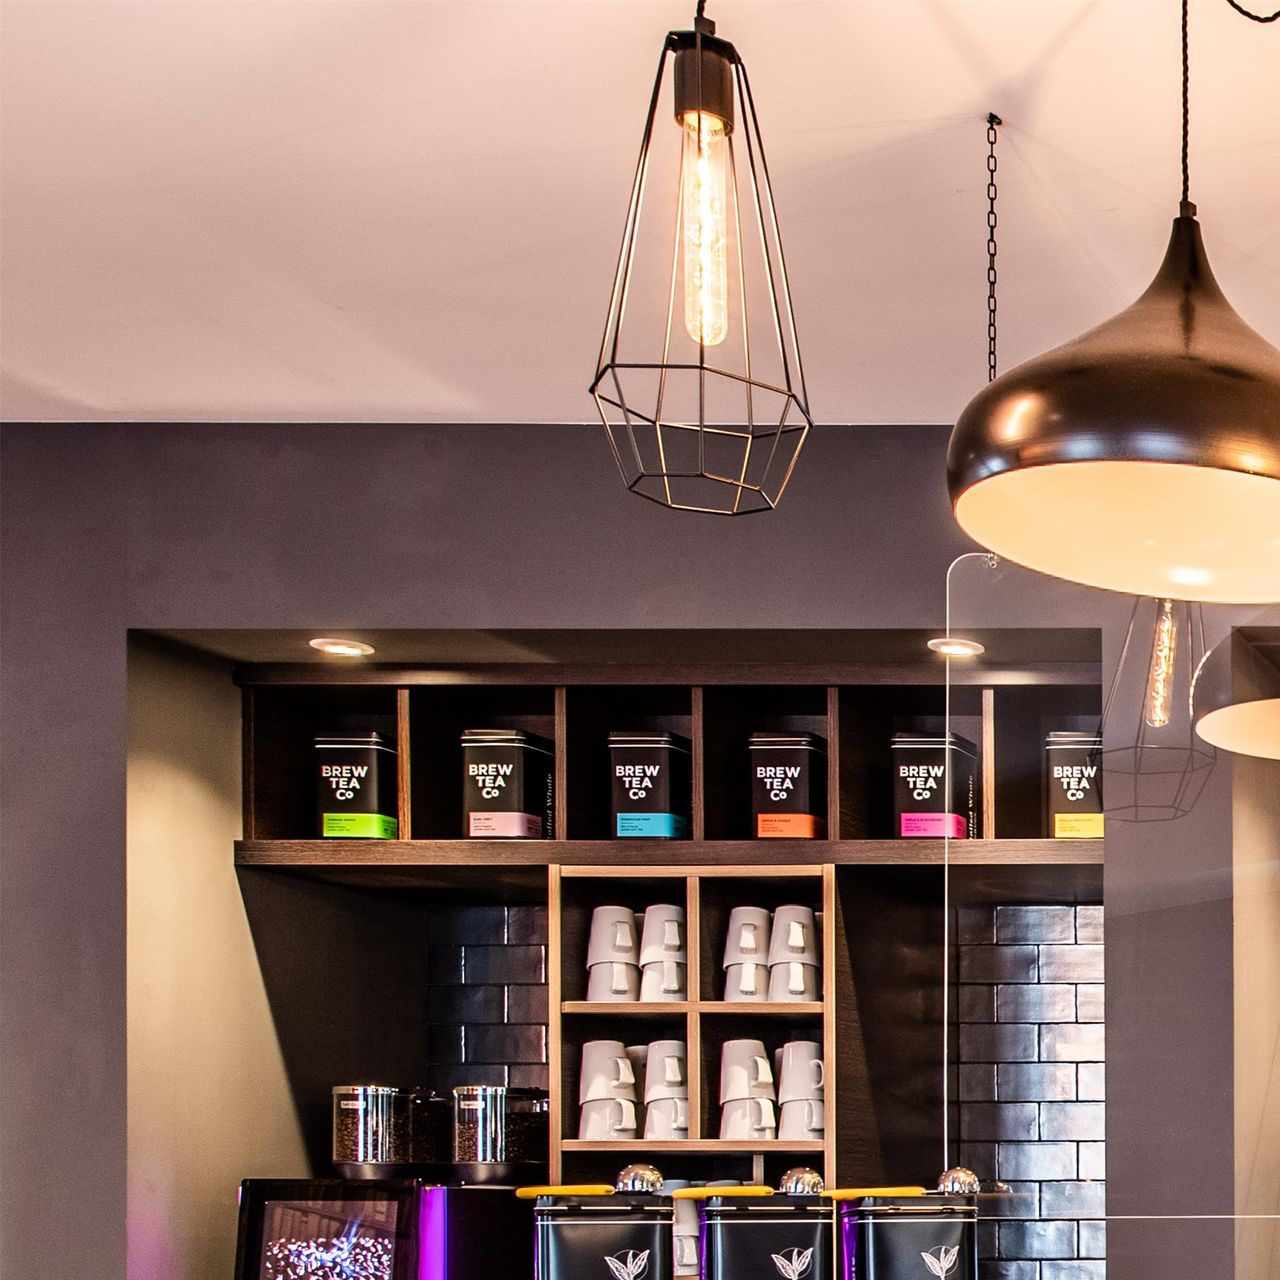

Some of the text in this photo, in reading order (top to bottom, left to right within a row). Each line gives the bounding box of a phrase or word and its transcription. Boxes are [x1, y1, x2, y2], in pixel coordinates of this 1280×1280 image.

[321, 766, 368, 778] BREW
[468, 764, 513, 776] BREW
[615, 765, 660, 776] BREW
[756, 767, 801, 778] BREW
[899, 765, 944, 777] BREW
[1053, 766, 1097, 778] BREW
[329, 778, 360, 789] TEA
[476, 776, 506, 787] TEA
[623, 777, 653, 788] TEA
[764, 778, 794, 789] TEA
[907, 777, 937, 789] TEA
[1060, 777, 1090, 789] TEA
